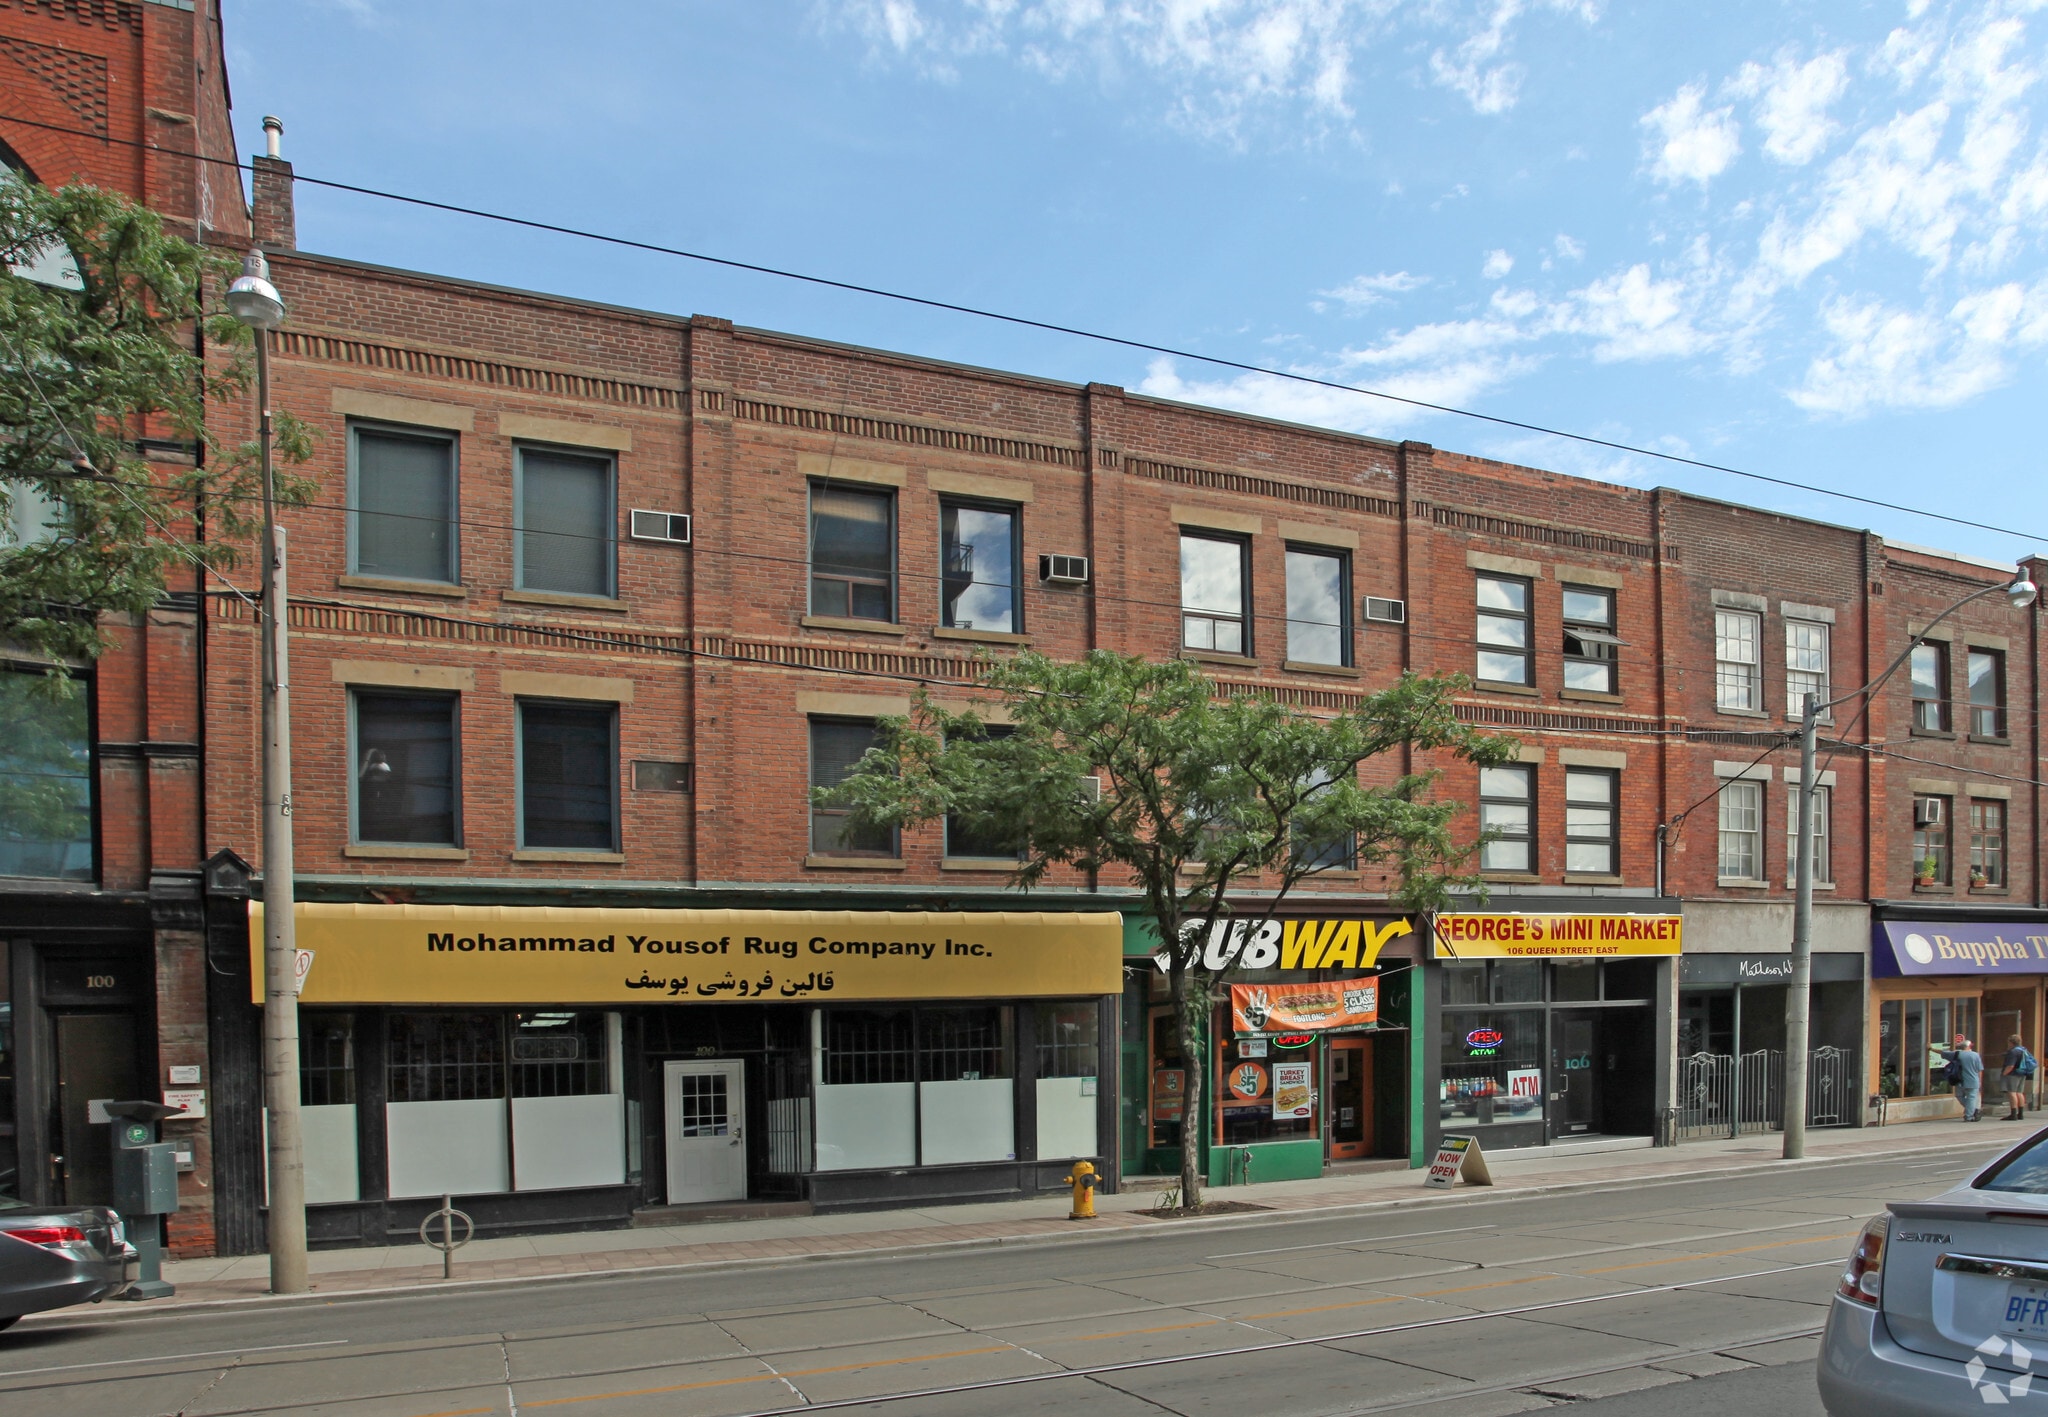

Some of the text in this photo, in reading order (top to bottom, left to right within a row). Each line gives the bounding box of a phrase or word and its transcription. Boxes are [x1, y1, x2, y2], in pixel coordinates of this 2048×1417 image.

[250, 259, 262, 268] 15
[1435, 918, 1680, 941] GEORGE'S MINI MARKET
[427, 933, 993, 960] Mohammad Yousof Rug Company Inc.
[1506, 946, 1619, 955] 106 QUEEN STREET EAST
[1932, 934, 2048, 967] Buppha T
[87, 975, 115, 988] 100
[1245, 1006, 1266, 1028] $5
[1293, 1012, 1326, 1023] FOOTLONG
[1468, 1031, 1502, 1043] OPEN
[1470, 1048, 1496, 1056] ATM
[1564, 1052, 1590, 1070] 106
[1241, 1075, 1257, 1094] $5
[1511, 1075, 1539, 1096] ATM
[1437, 1152, 1461, 1164] NOW
[1430, 1165, 1457, 1178] OPEN
[1896, 1231, 1954, 1245] SENTRA
